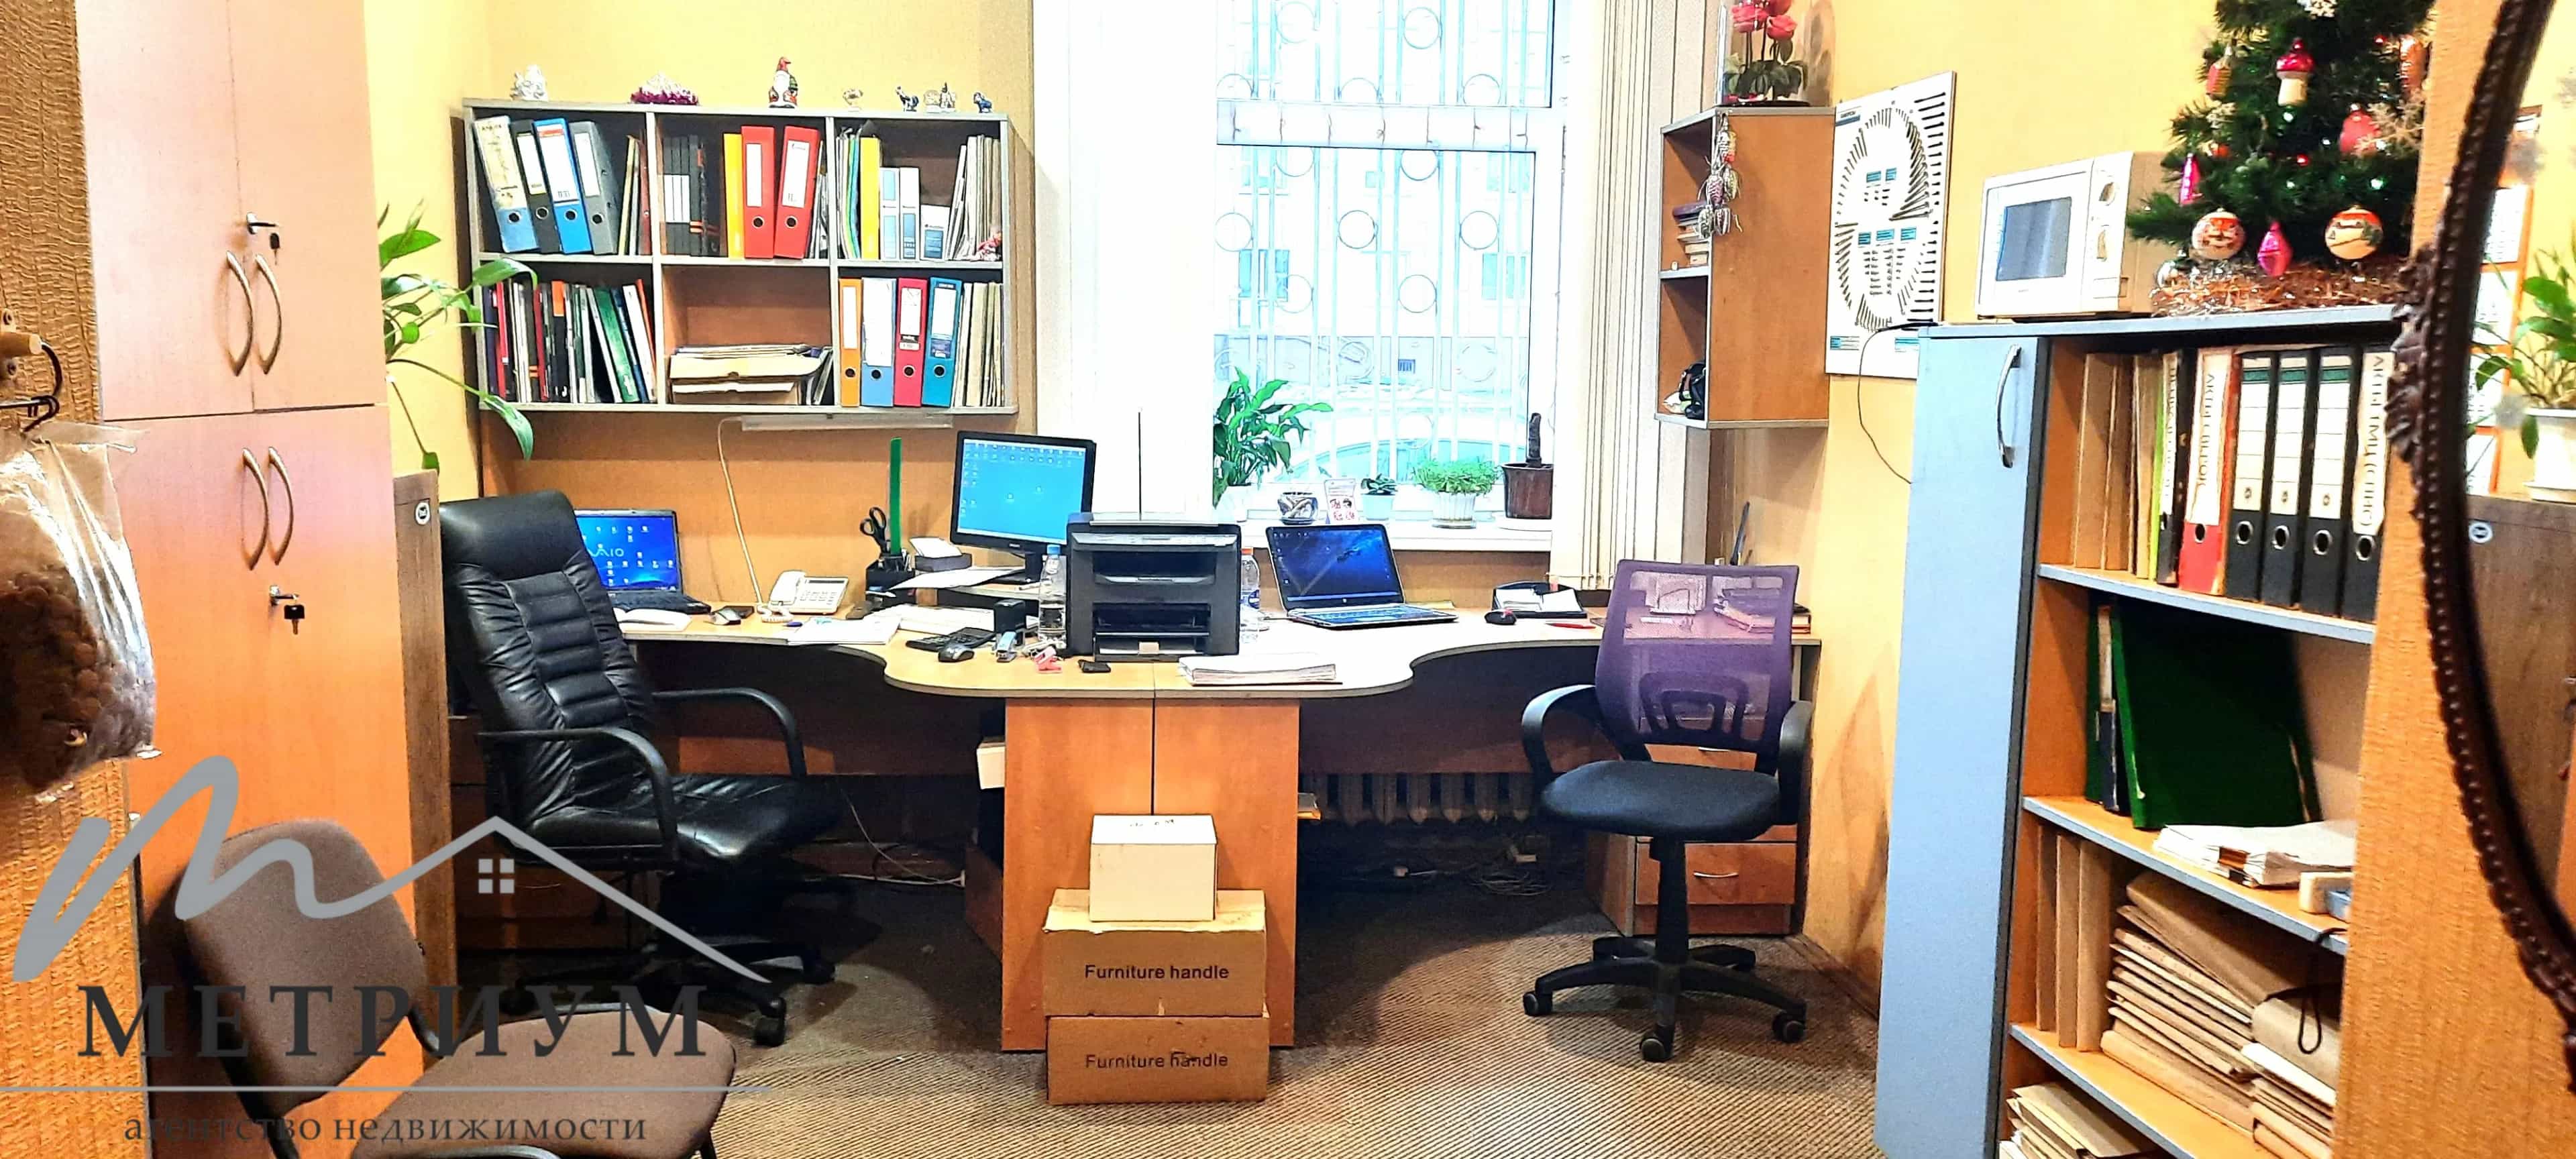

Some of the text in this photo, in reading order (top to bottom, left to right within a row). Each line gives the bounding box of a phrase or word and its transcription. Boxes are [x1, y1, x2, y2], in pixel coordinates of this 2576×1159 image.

[2369, 355, 2384, 406] АКТЫ
[1085, 964, 1230, 979] Furniture handle
[1085, 1052, 1229, 1068] Furniture handle
